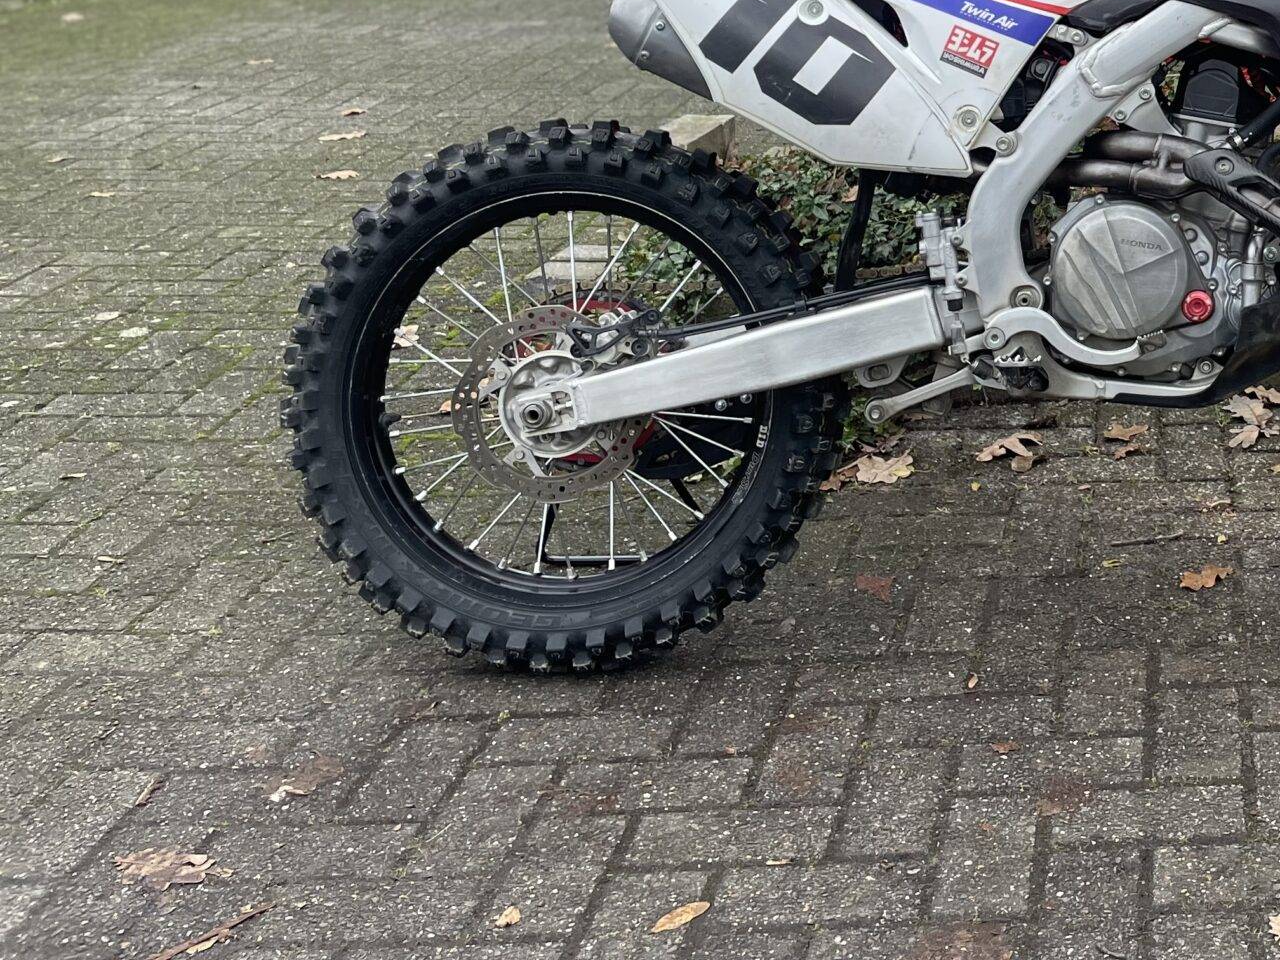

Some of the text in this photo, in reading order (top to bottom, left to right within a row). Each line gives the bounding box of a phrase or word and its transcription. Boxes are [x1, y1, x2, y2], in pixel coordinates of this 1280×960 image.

[960, 0, 996, 23] Twin
[995, 15, 1019, 30] Air
[1120, 237, 1166, 252] HONDA
